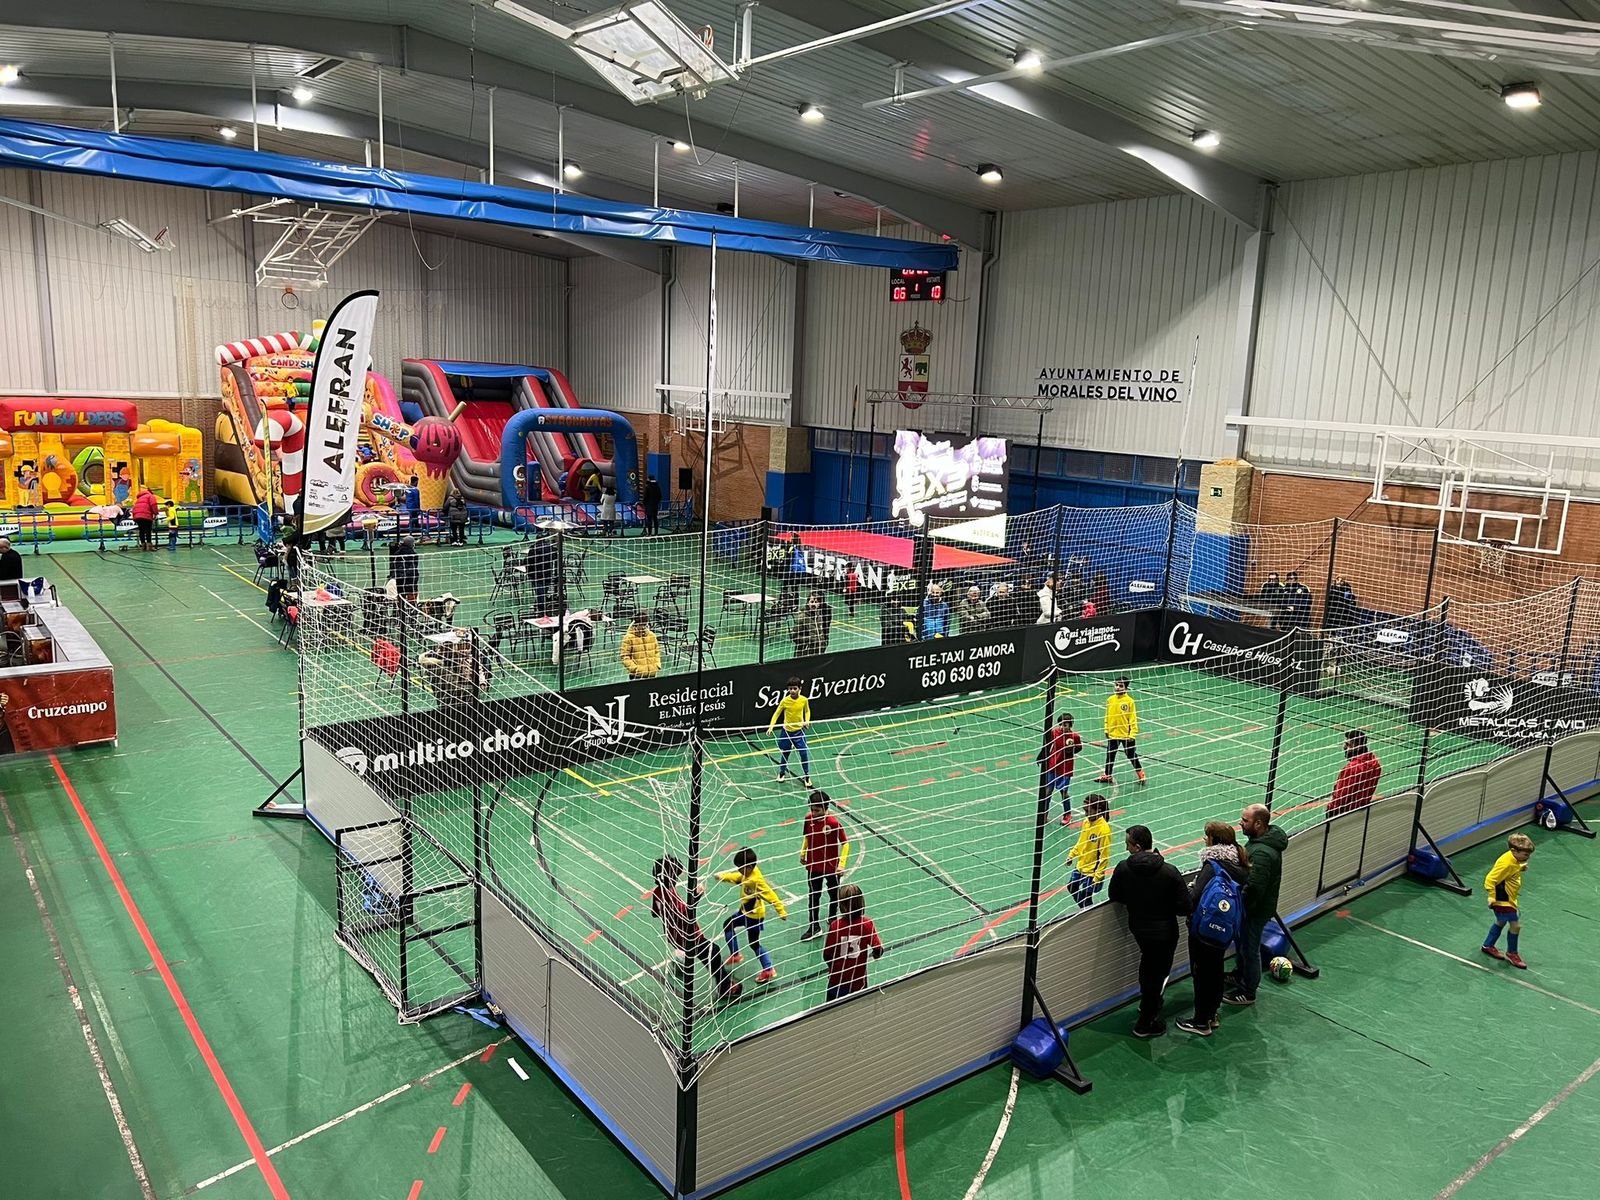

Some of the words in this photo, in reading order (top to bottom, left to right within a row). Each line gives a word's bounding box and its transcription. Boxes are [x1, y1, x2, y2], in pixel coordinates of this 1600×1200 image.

[893, 287, 906, 300] 06
[931, 285, 941, 299] 10
[270, 359, 299, 367] CANDY
[1039, 368, 1153, 381] AYUNTAMIENTO
[1160, 370, 1180, 382] DE
[1038, 384, 1103, 399] MORALES
[1107, 386, 1135, 400] DEL
[1139, 387, 1177, 401] VINO
[323, 328, 357, 475] ALEFRAN
[14, 410, 48, 426] FUN
[803, 550, 882, 592] LEFRAN
[1074, 636, 1087, 645] sin
[908, 649, 965, 670] TELE-TAXI
[969, 642, 1016, 660] ZAMORA
[1203, 640, 1244, 657] Castaño
[1244, 650, 1253, 659] e
[921, 669, 946, 688] 630
[950, 664, 974, 683] 630
[977, 660, 1001, 678] 630
[648, 680, 735, 708] Residencial
[807, 672, 886, 700] Eventos
[28, 700, 107, 719] Cruzcampo
[699, 698, 726, 715] Jesús
[1459, 717, 1538, 728] METALICAS
